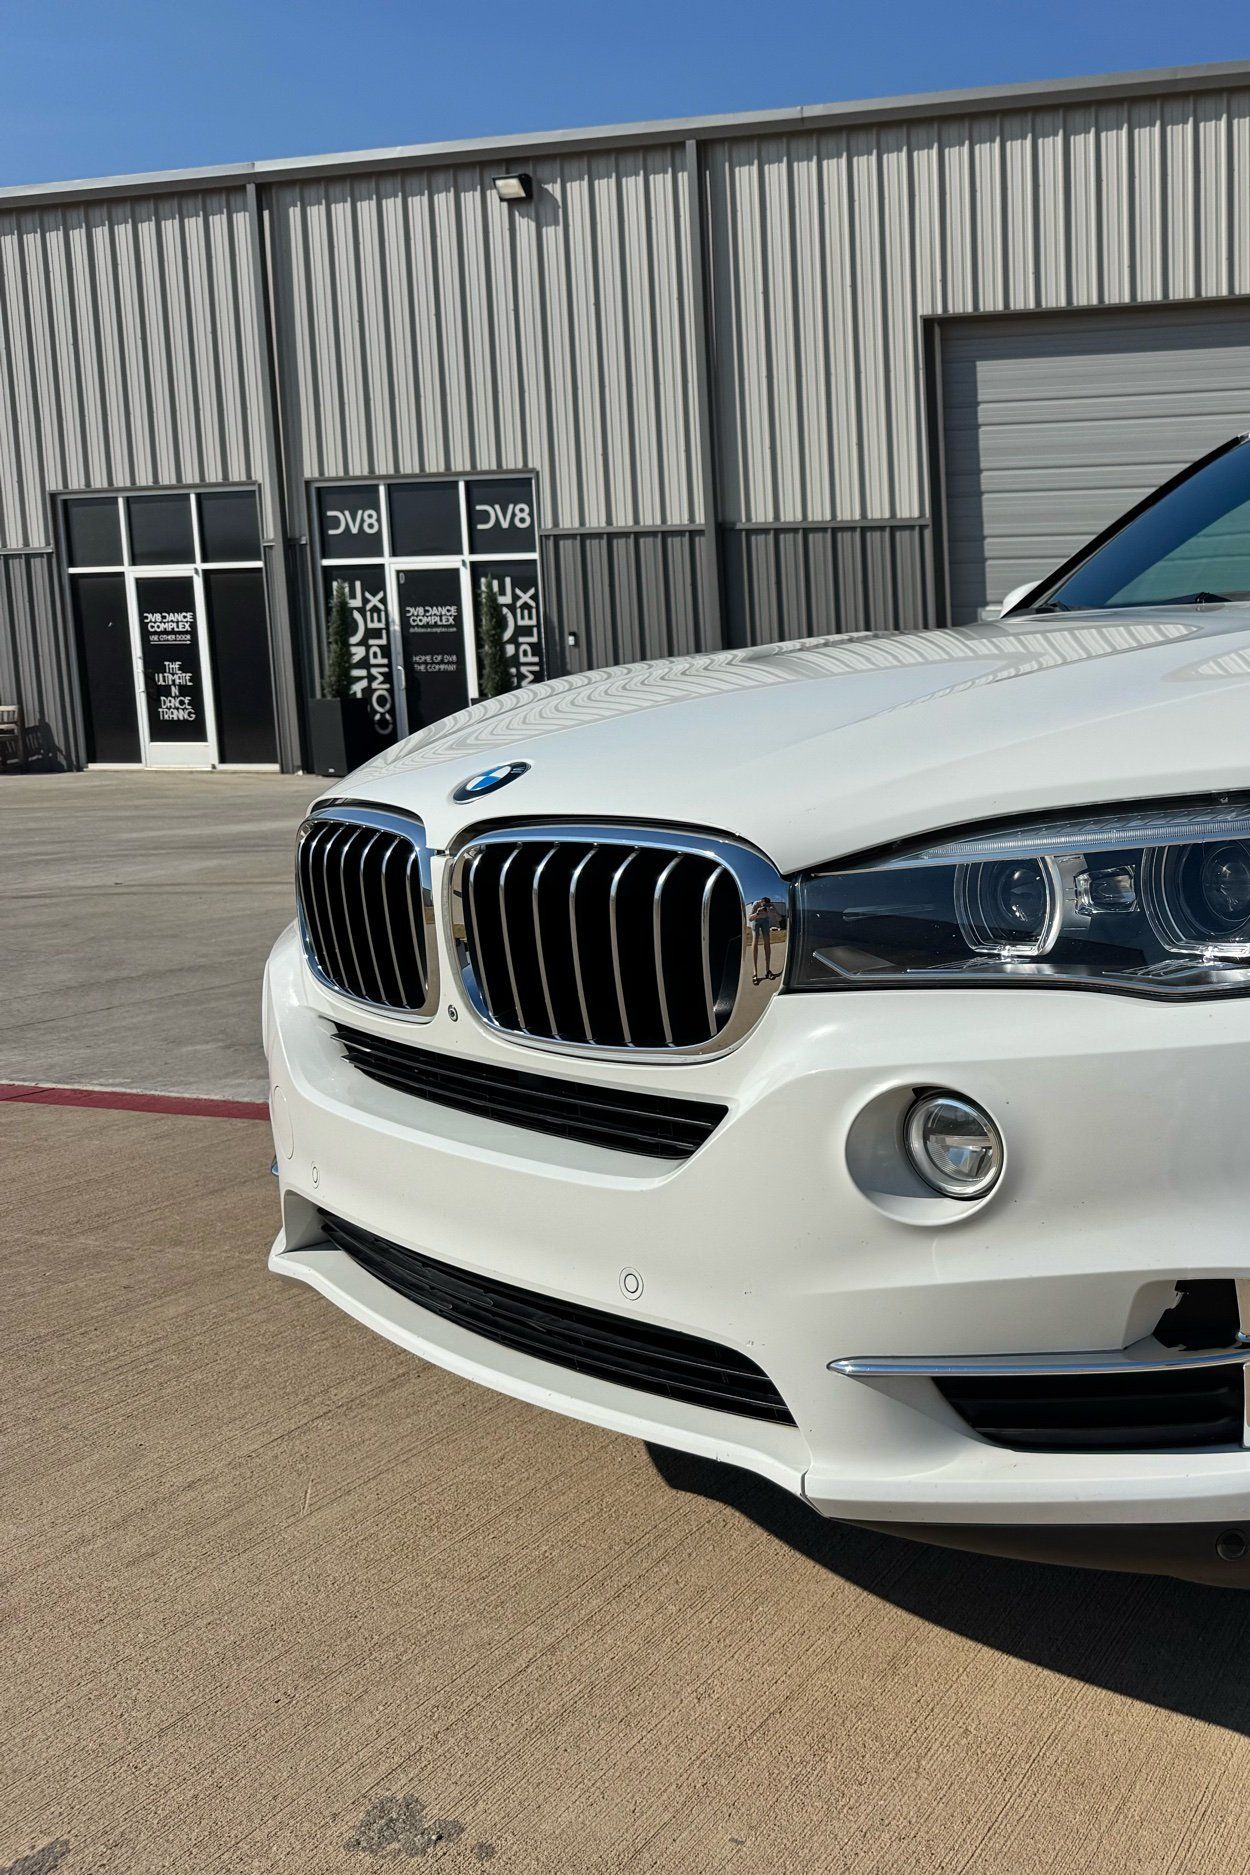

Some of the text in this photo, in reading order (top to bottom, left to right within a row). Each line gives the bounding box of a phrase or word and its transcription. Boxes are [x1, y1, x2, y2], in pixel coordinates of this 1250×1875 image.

[326, 509, 379, 535] DV8
[475, 503, 531, 530] DV8
[143, 612, 194, 622] DV8 DANCE
[405, 605, 458, 616] DV8 DANCE
[148, 622, 191, 631] COMPLEX
[409, 615, 455, 626] COMPLEX
[514, 586, 540, 687] MPLEX
[364, 590, 394, 735] COMPLEX
[412, 654, 432, 663] HOME
[433, 654, 443, 663] OF
[164, 661, 182, 674] THE
[155, 673, 193, 686] ULTIMATE
[160, 696, 192, 709] DANCE
